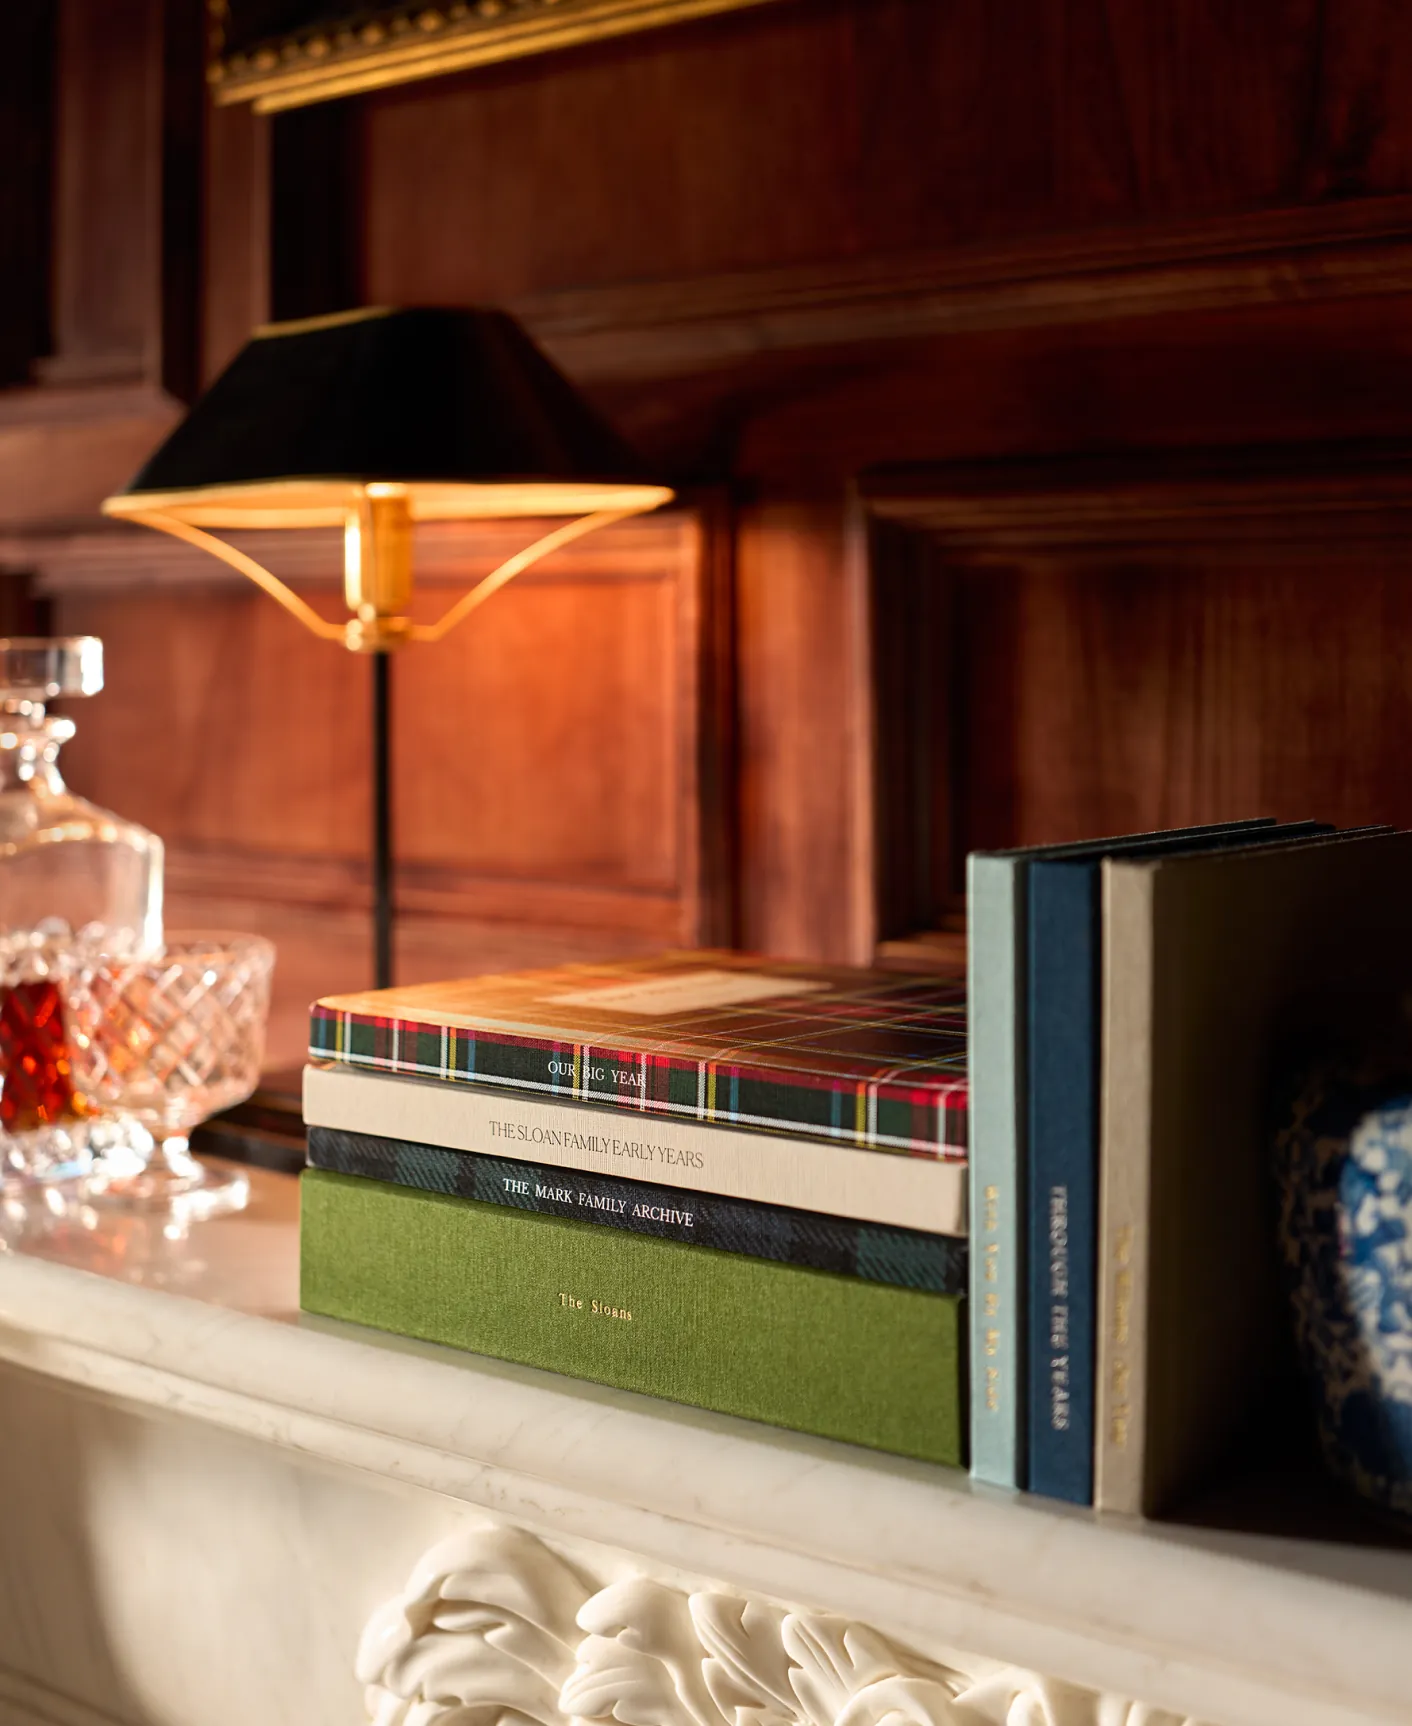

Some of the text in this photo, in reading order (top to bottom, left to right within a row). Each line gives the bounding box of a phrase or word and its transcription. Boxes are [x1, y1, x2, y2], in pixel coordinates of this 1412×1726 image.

[547, 1060, 646, 1088] OUR BIG YEAR
[489, 1120, 704, 1169] THE SLOAN FAMILY EARLY YEARS
[503, 1178, 694, 1227] THE MARK FAMILY ARCHIVE
[558, 1292, 632, 1320] The Sloans
[1050, 1354, 1071, 1431] YEARS
